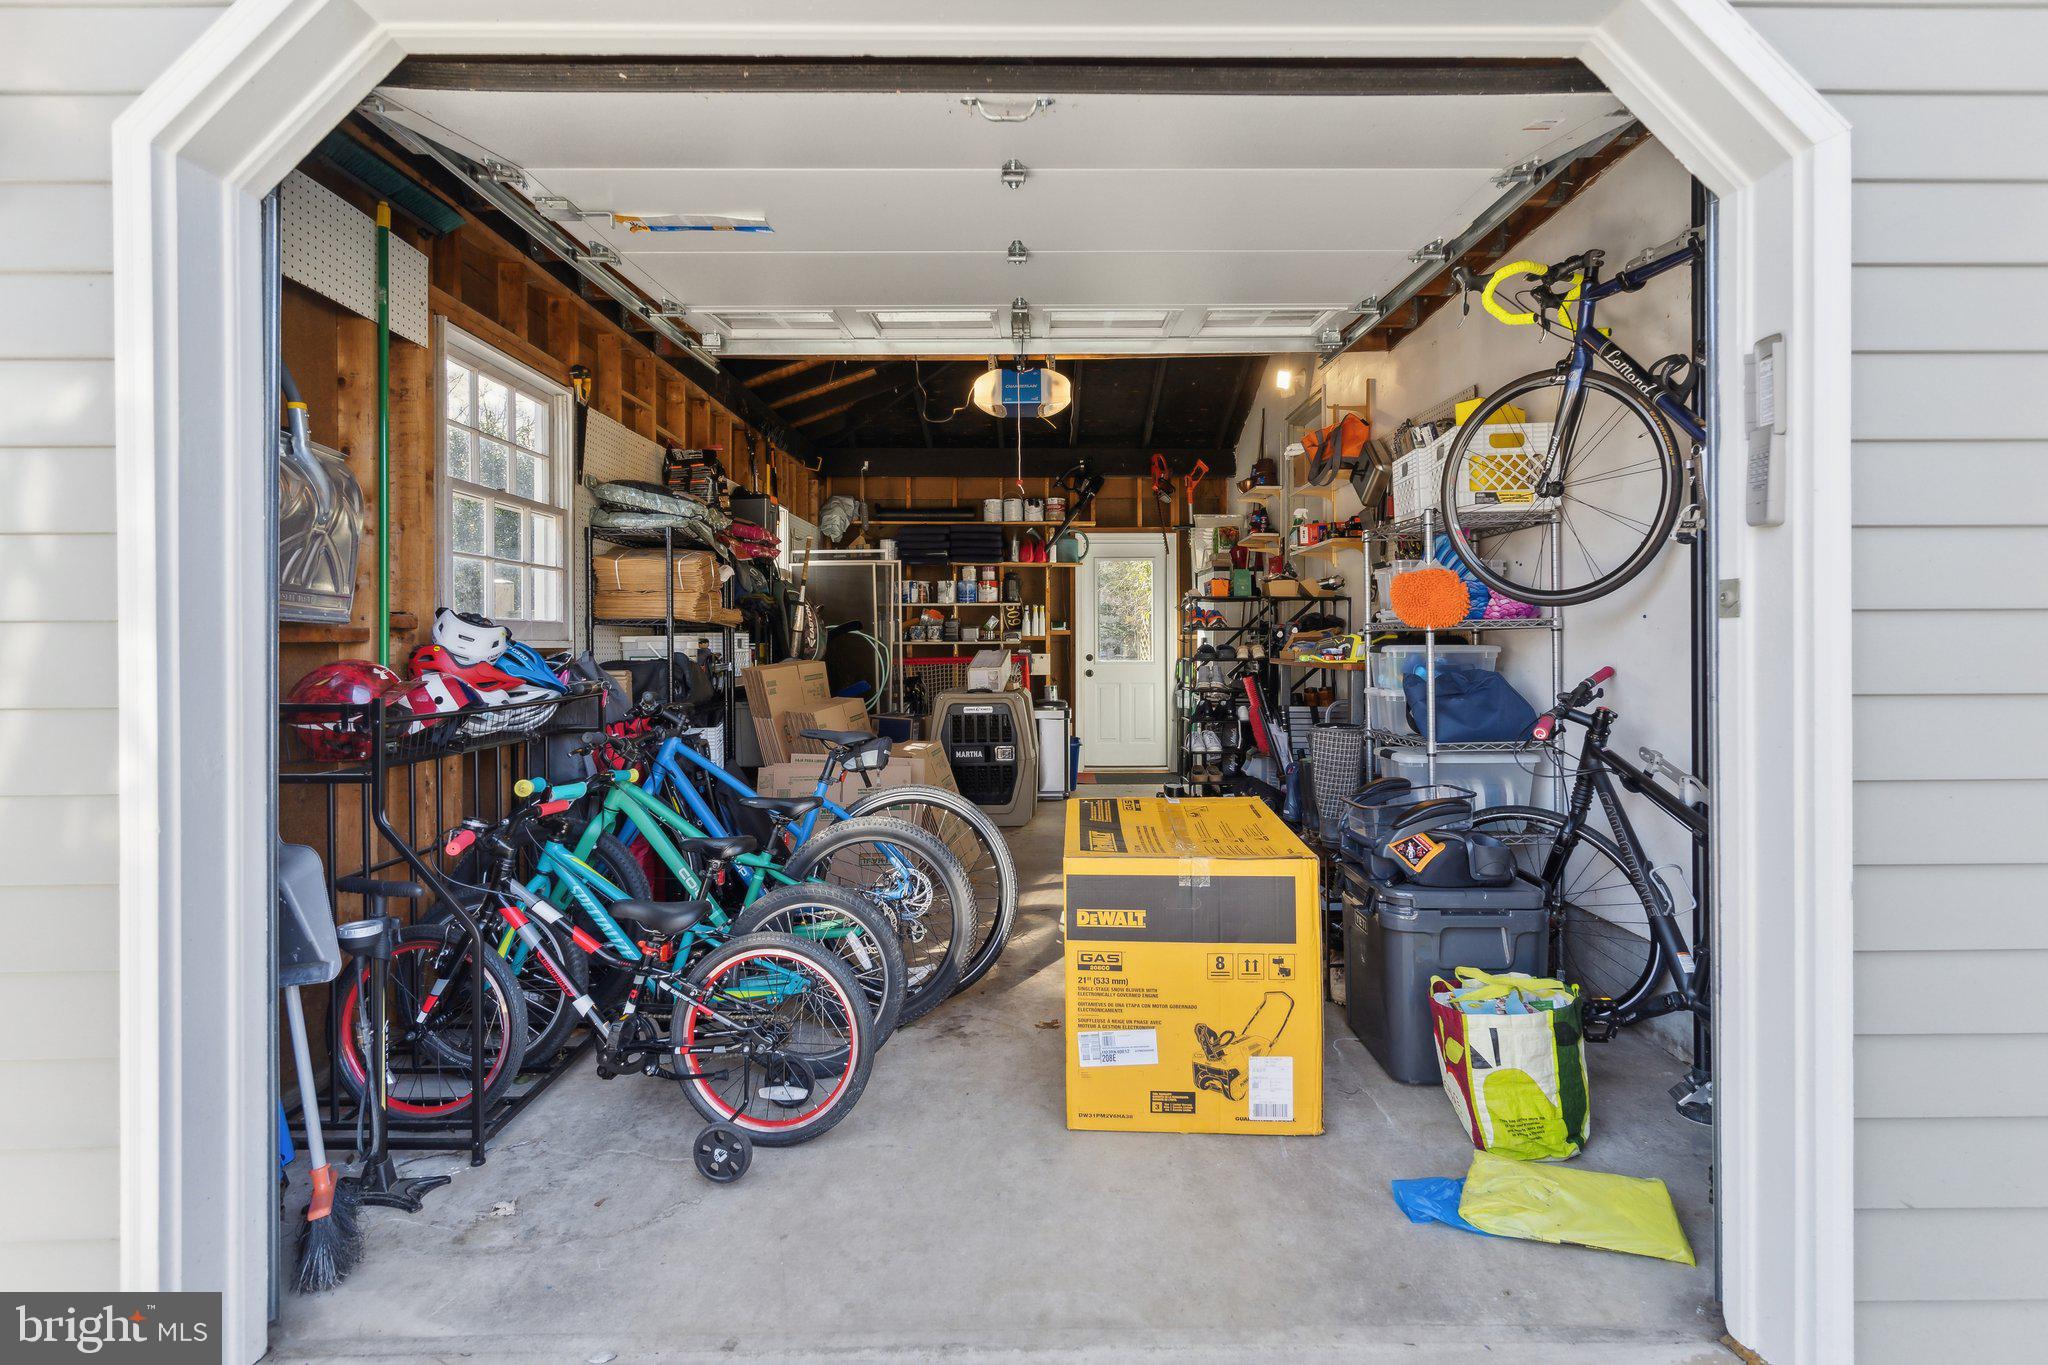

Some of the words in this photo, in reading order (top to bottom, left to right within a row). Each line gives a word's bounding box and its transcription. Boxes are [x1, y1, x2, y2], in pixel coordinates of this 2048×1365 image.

[1603, 350, 1658, 398] LeMond
[955, 750, 983, 758] MARTHA
[572, 885, 634, 959] SPECIALIZE
[1356, 914, 1367, 931] YETI
[1080, 953, 1120, 963] GAS
[1215, 956, 1225, 970] 8
[1093, 977, 1110, 986] (533
[1111, 978, 1129, 986] mm)
